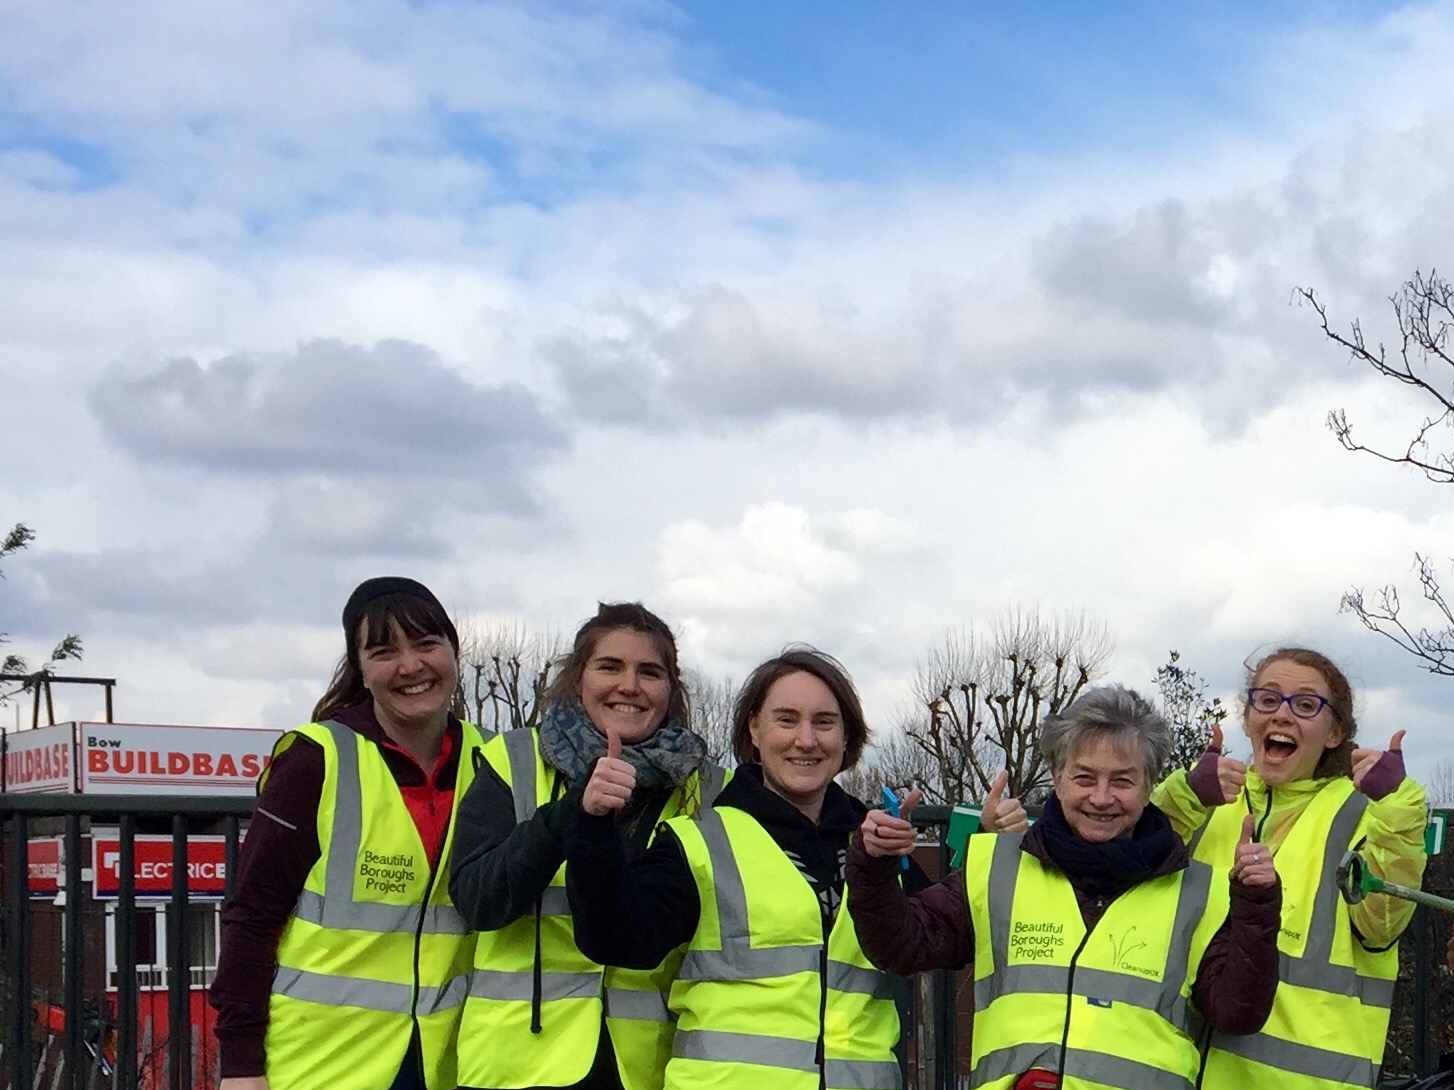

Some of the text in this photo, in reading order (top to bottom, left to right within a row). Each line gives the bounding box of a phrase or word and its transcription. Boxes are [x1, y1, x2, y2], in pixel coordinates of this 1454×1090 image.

[87, 736, 121, 748] Bow
[4, 743, 69, 785] UILDBASE
[364, 850, 413, 867] Beautiful
[360, 863, 415, 882] Boroughs
[365, 877, 406, 894] Project
[1014, 921, 1064, 934] Beautiful
[1010, 934, 1064, 948] Boroughs
[1014, 946, 1054, 961] Project
